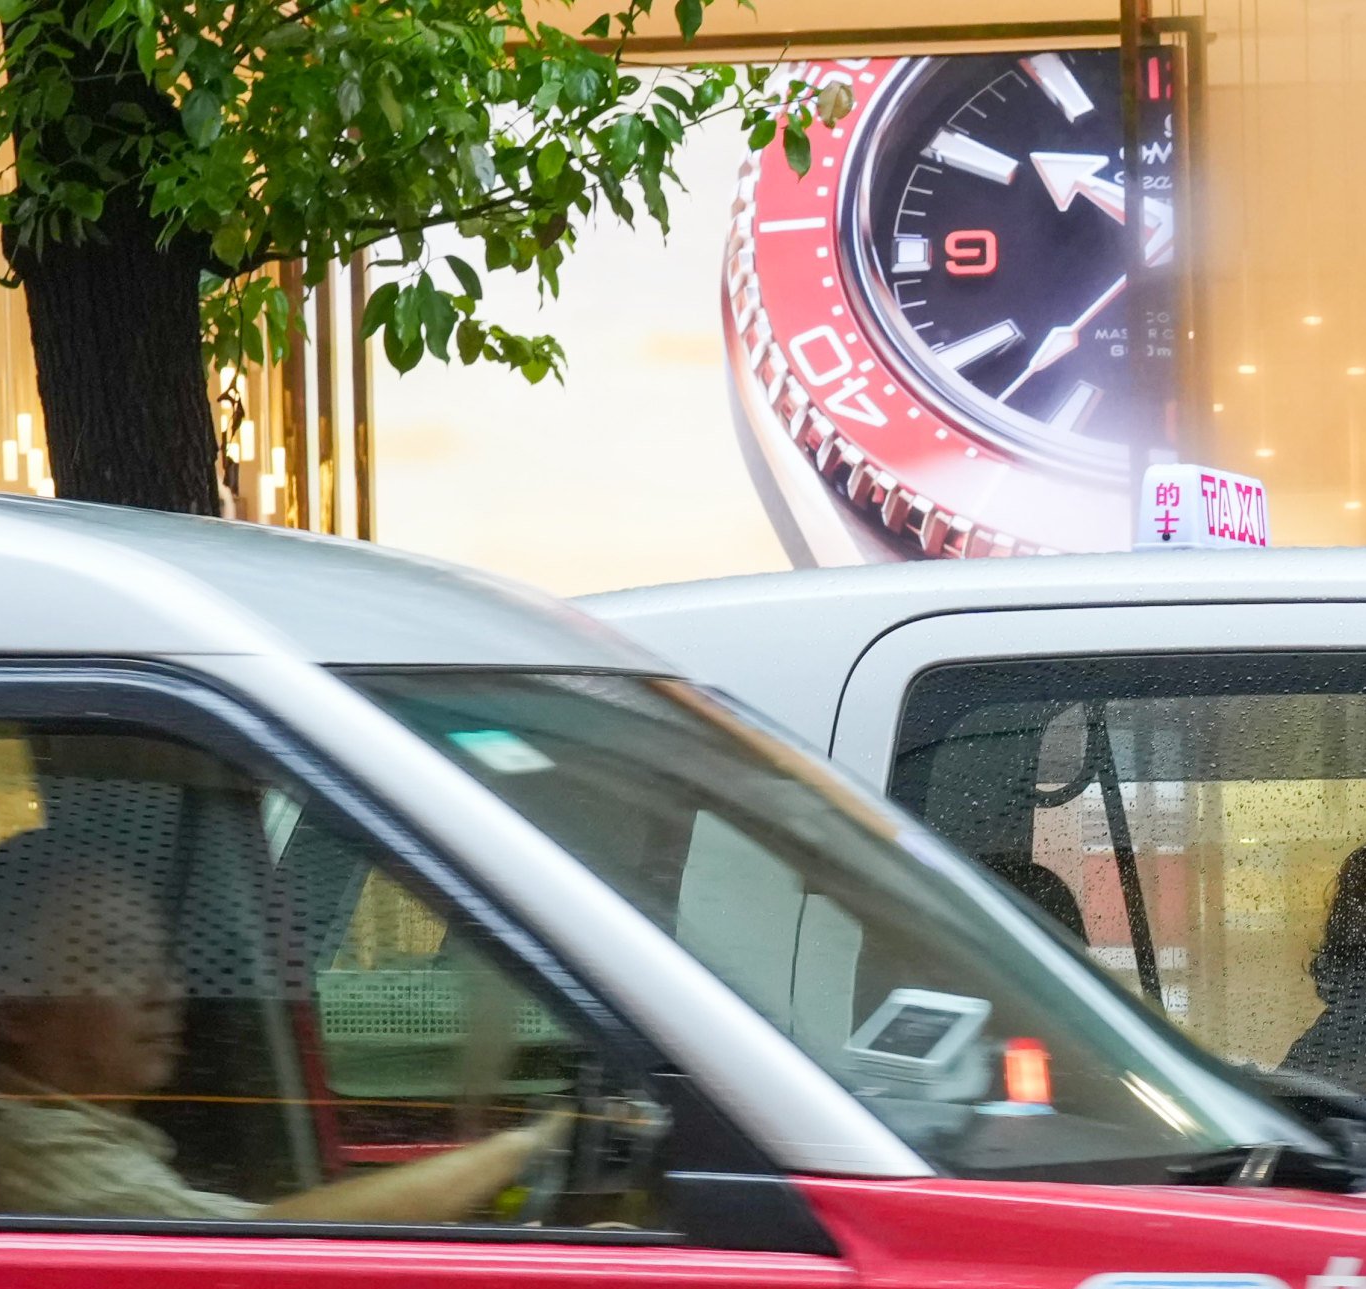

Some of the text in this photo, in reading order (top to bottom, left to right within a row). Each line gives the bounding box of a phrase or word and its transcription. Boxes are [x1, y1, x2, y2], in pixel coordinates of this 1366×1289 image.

[944, 229, 998, 276] 9
[788, 324, 889, 428] 40
[1154, 482, 1180, 534] 的士
[1200, 474, 1266, 547] TAXI
